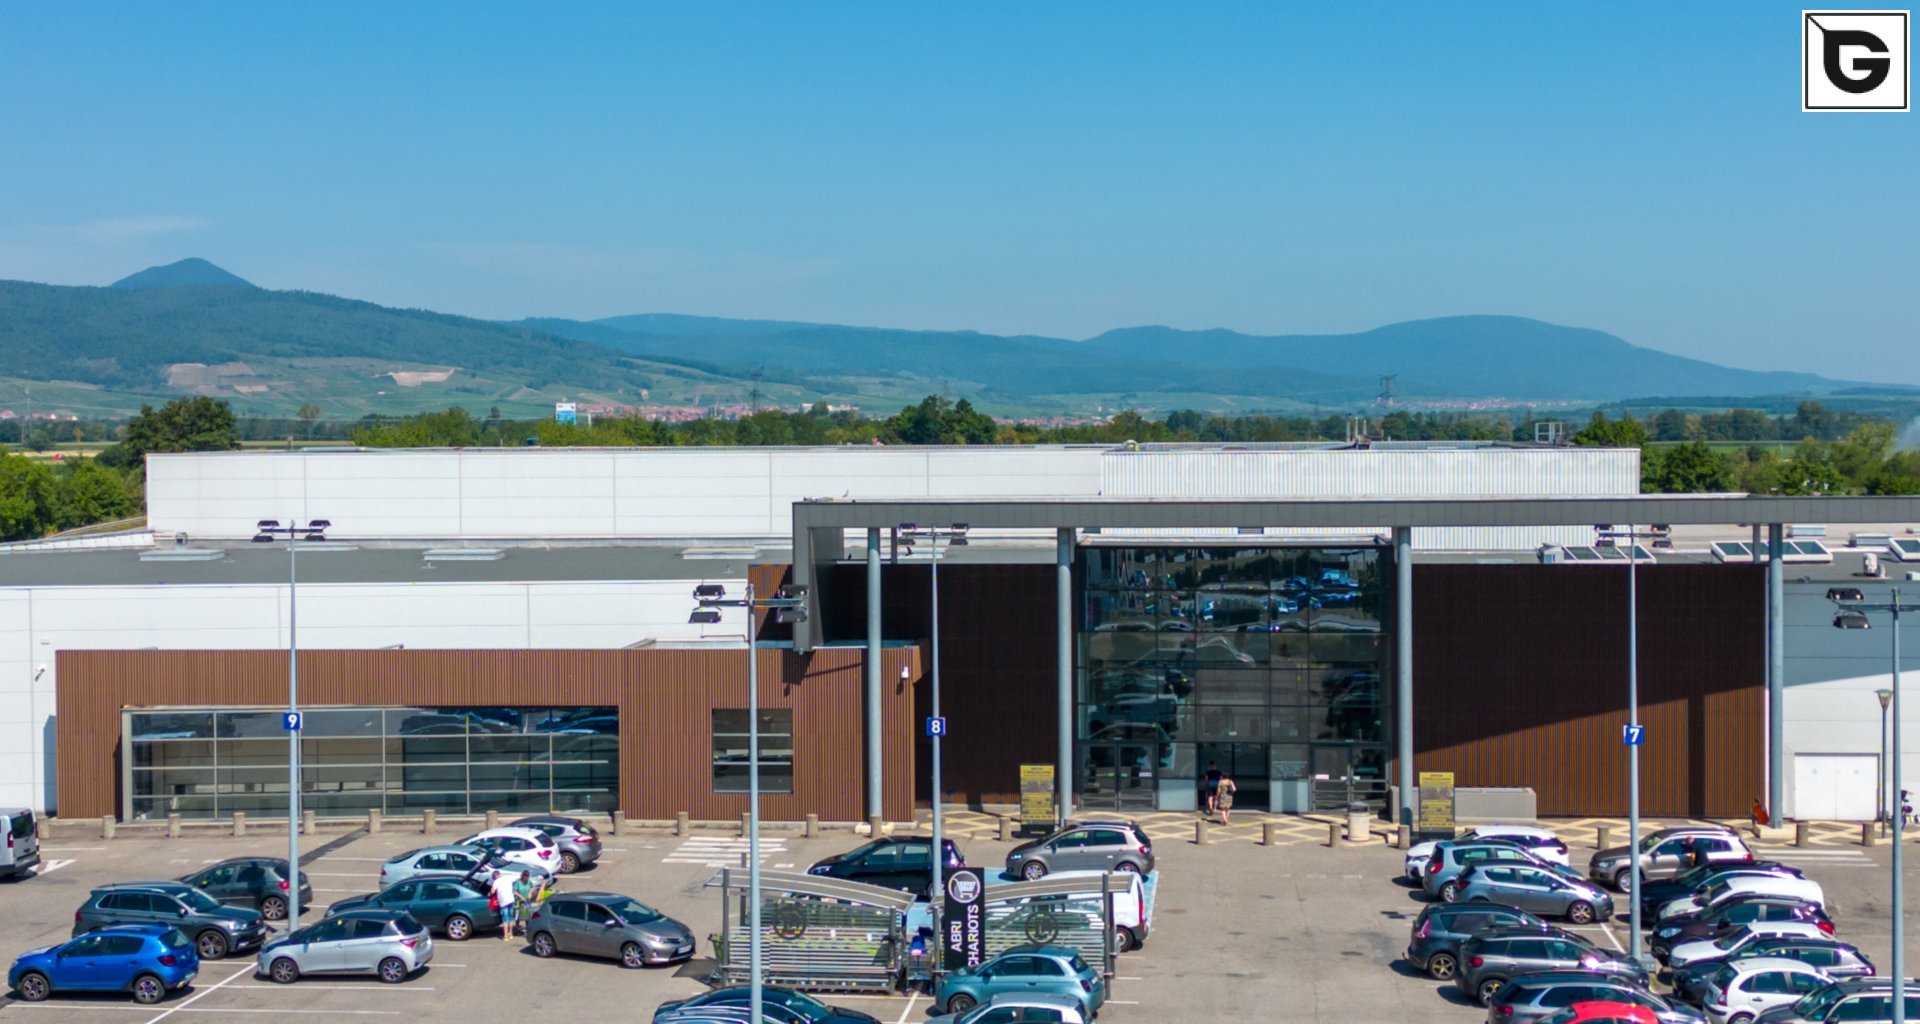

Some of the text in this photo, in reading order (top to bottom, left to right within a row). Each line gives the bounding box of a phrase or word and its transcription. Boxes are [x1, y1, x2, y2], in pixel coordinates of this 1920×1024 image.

[288, 713, 298, 728] 9
[931, 720, 941, 734] 8
[1629, 728, 1640, 743] 7
[951, 921, 963, 953] ABRI
